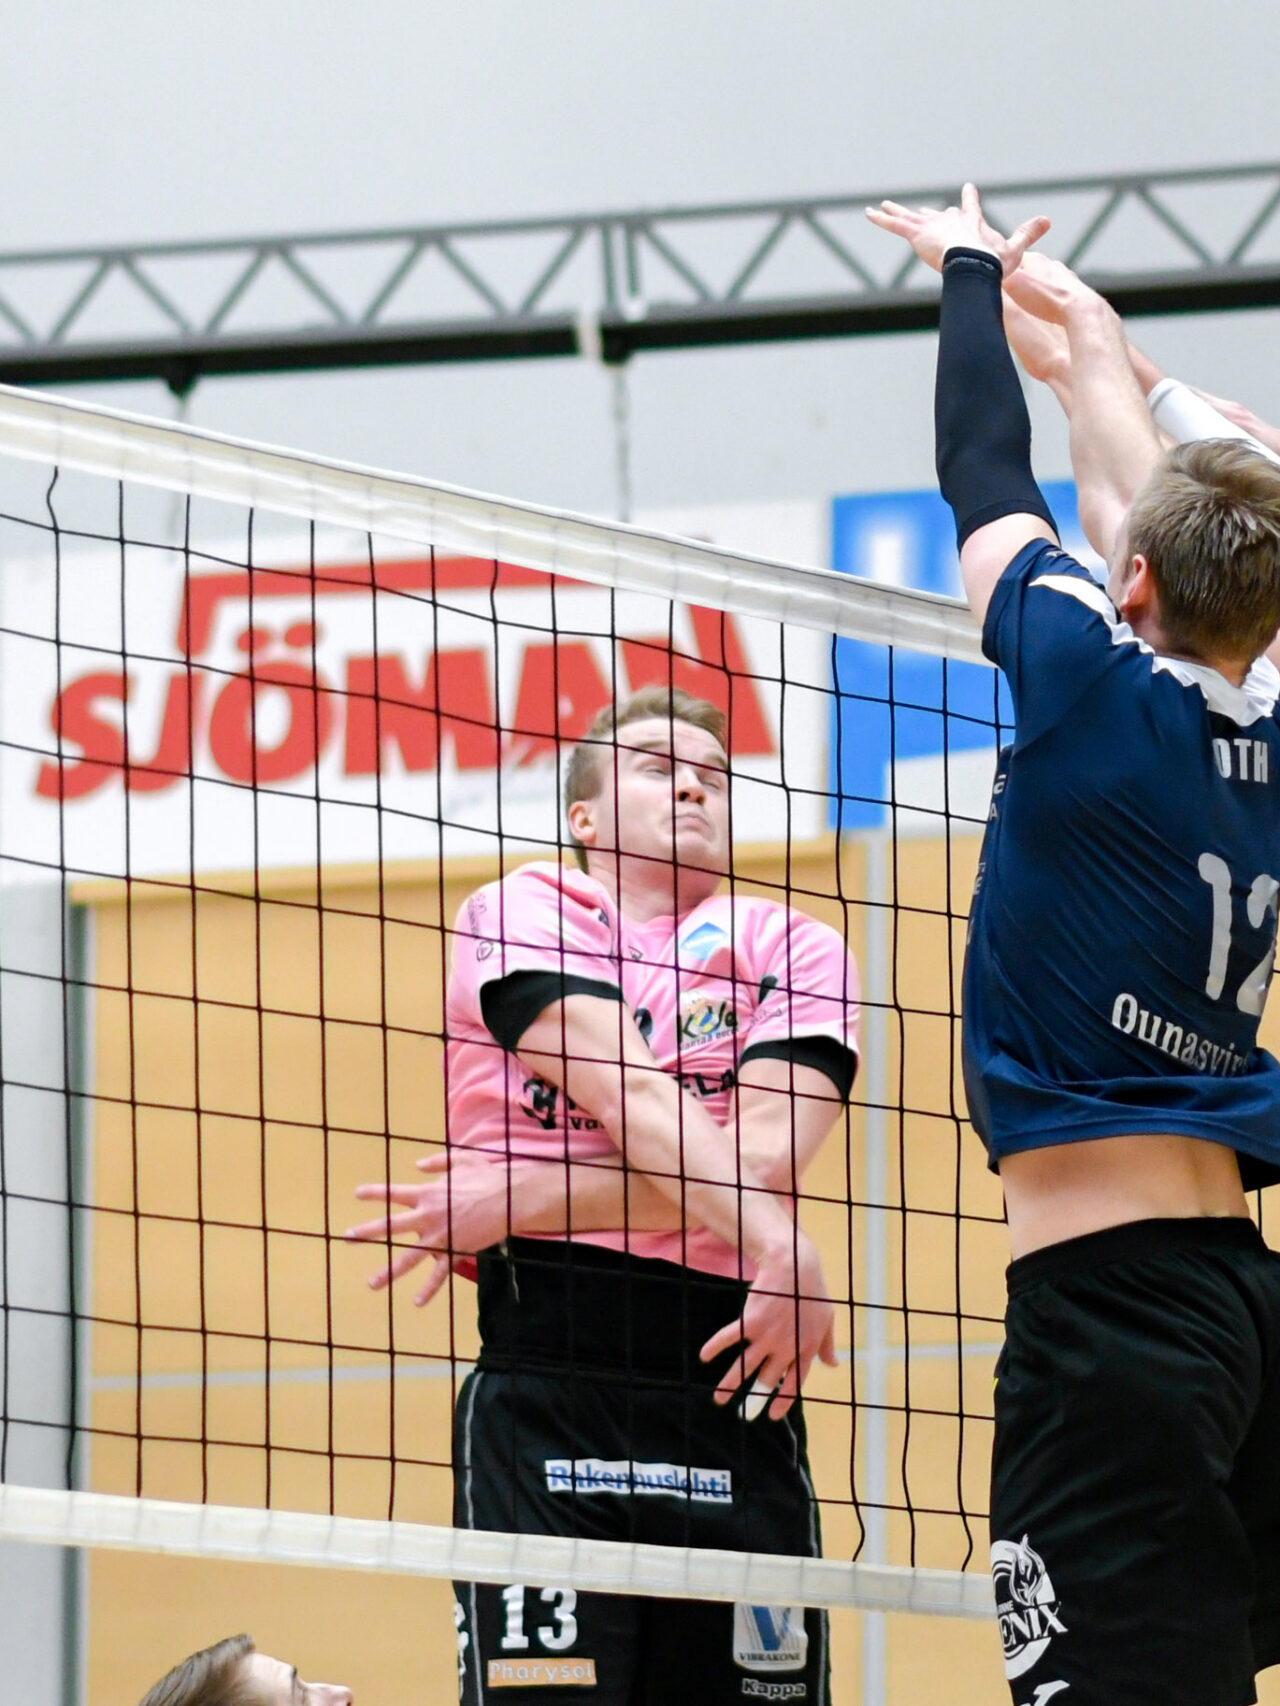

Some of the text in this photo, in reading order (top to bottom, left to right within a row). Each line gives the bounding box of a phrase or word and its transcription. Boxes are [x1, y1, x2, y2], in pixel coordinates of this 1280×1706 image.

[1198, 852, 1280, 1017] 12
[1111, 993, 1250, 1078] Ounasvir
[501, 1584, 578, 1650] 13
[489, 1661, 593, 1685] Pharysol
[741, 1677, 807, 1700] Kappa
